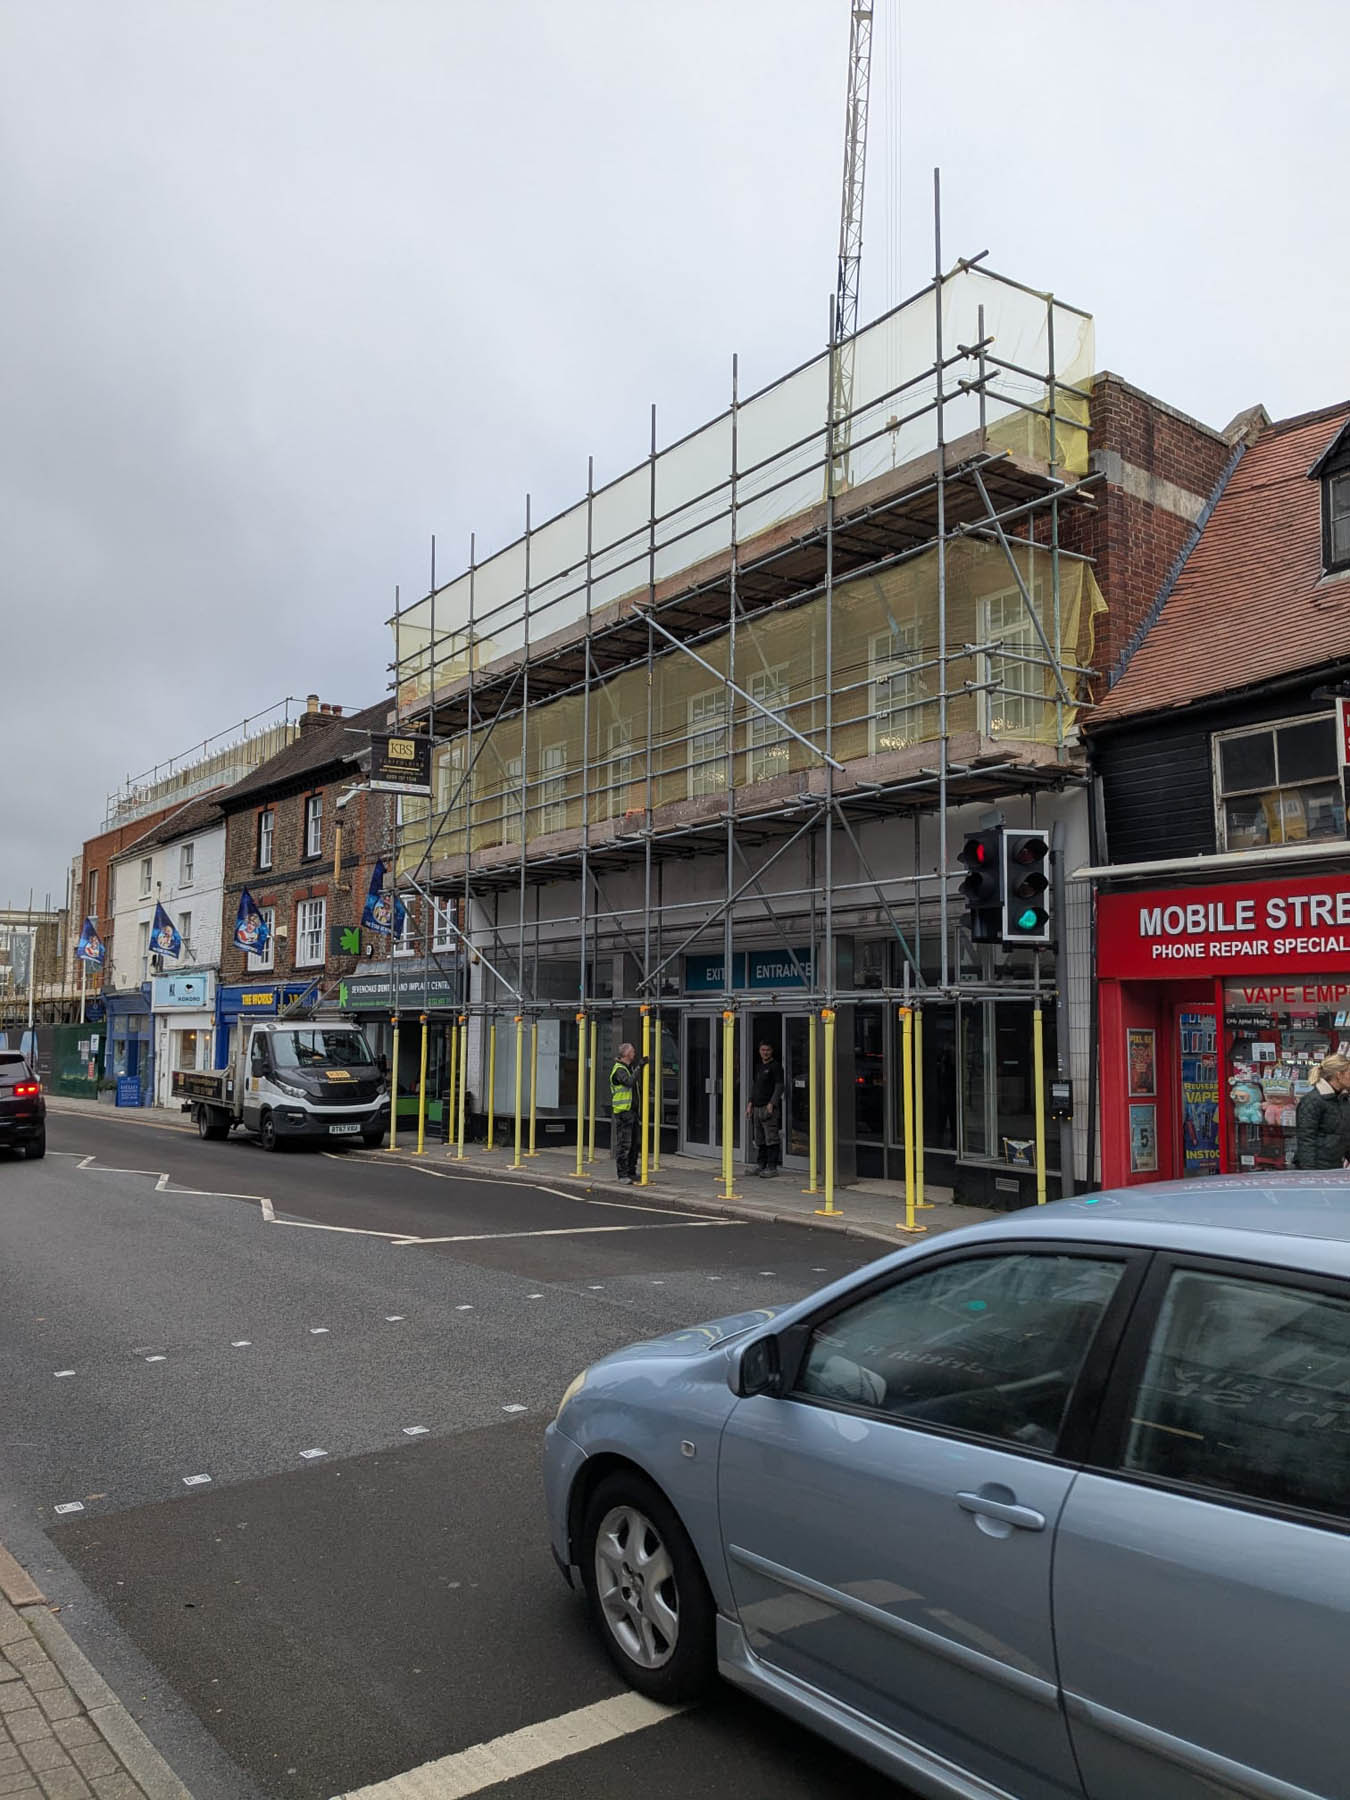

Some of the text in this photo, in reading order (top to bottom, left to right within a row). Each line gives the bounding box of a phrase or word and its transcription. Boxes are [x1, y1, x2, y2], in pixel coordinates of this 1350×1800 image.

[391, 743, 413, 755] KBS
[1139, 900, 1255, 936] MOBILE
[1152, 935, 1350, 959] PHONE REPAIR SPECIAL
[1243, 986, 1297, 1004] VAPE
